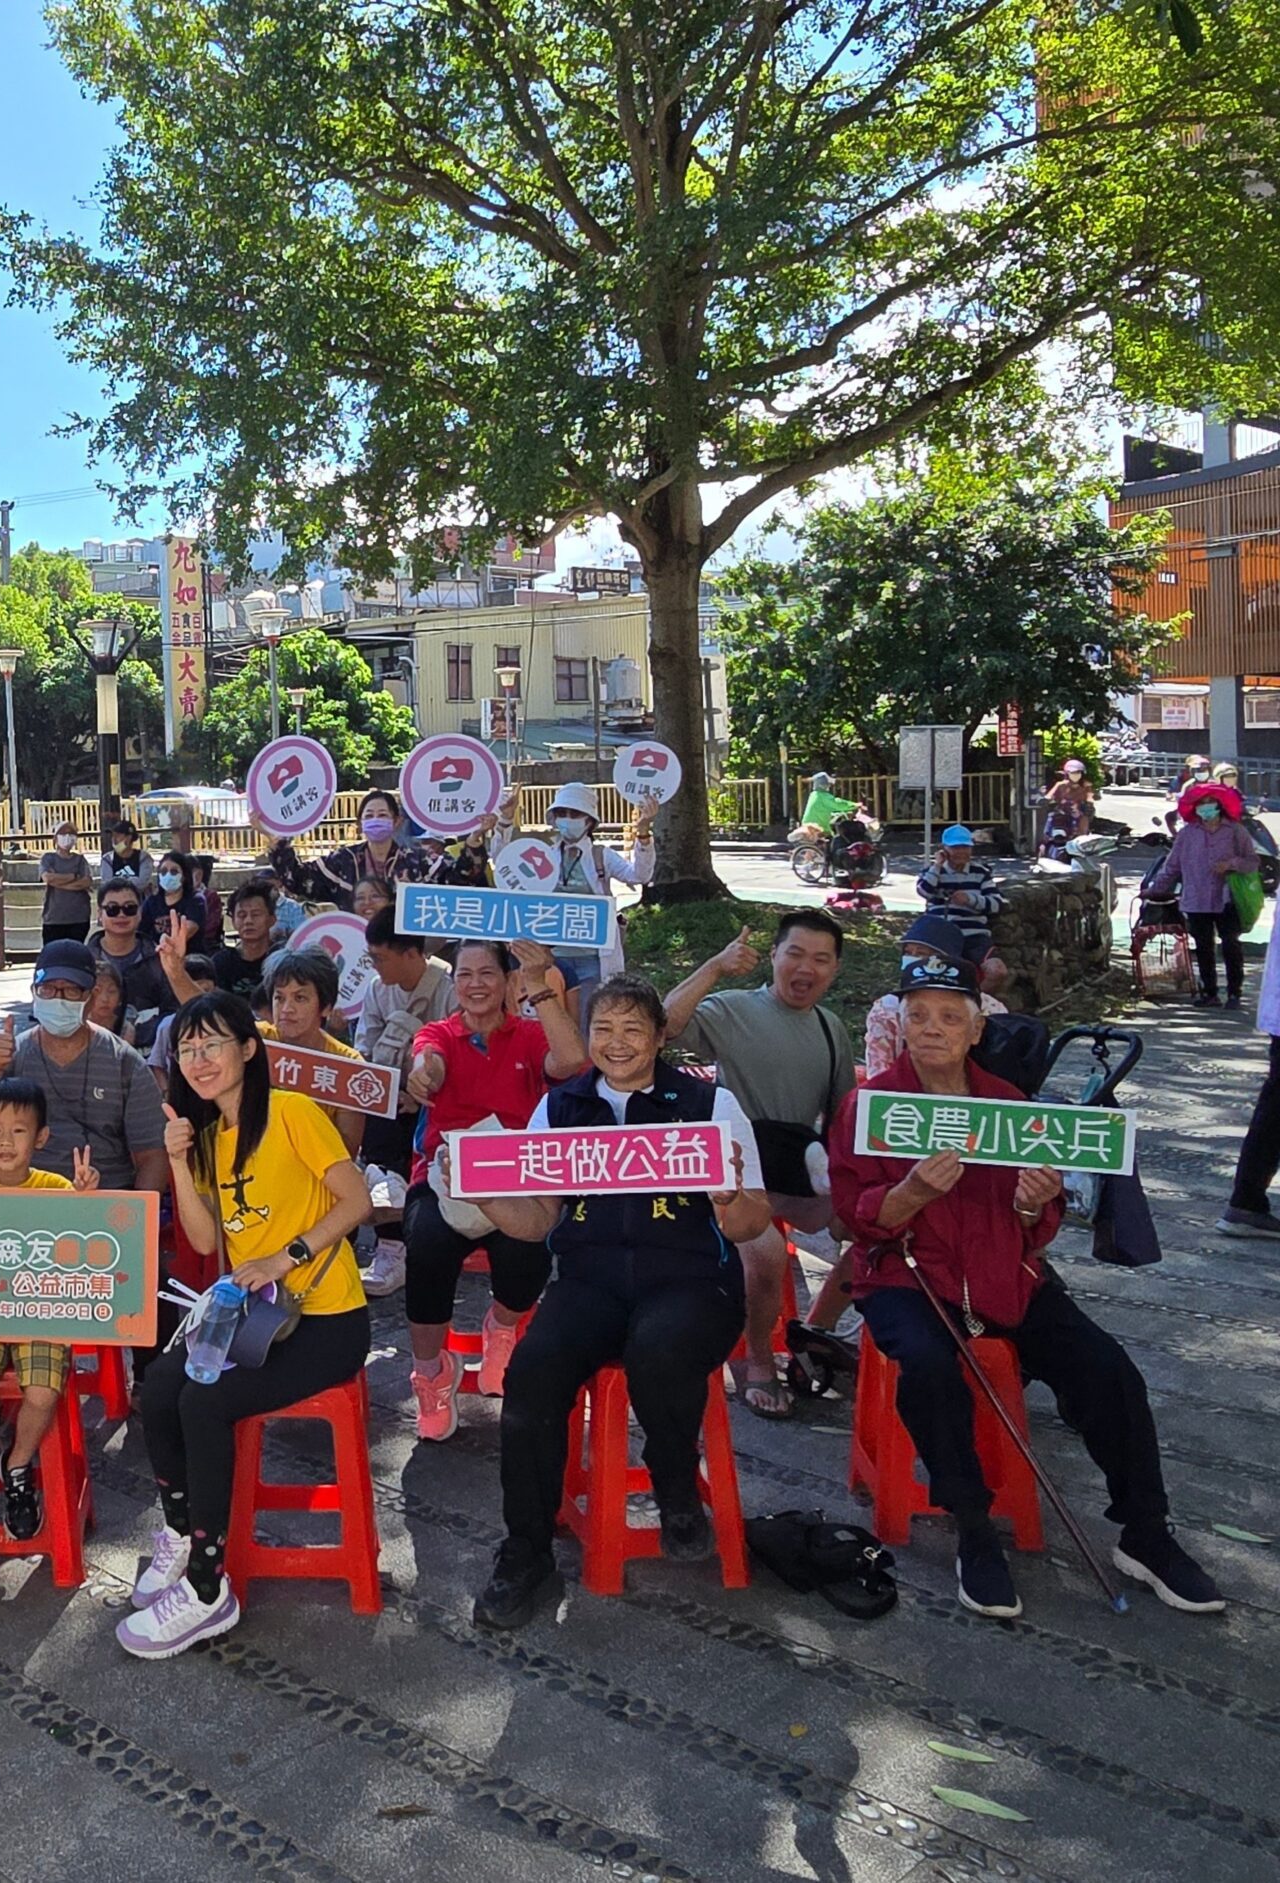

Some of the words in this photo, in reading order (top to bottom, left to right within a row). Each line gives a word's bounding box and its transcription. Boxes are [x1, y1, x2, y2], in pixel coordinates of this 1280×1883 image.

[172, 540, 198, 606] 九如
[171, 612, 181, 647] 五金
[413, 894, 597, 941] 我是小老闆
[274, 1056, 339, 1094] 竹東
[881, 1102, 1112, 1163] 食農小尖兵
[472, 1130, 711, 1184] 一起做公益
[12, 1272, 114, 1299] 公益市集
